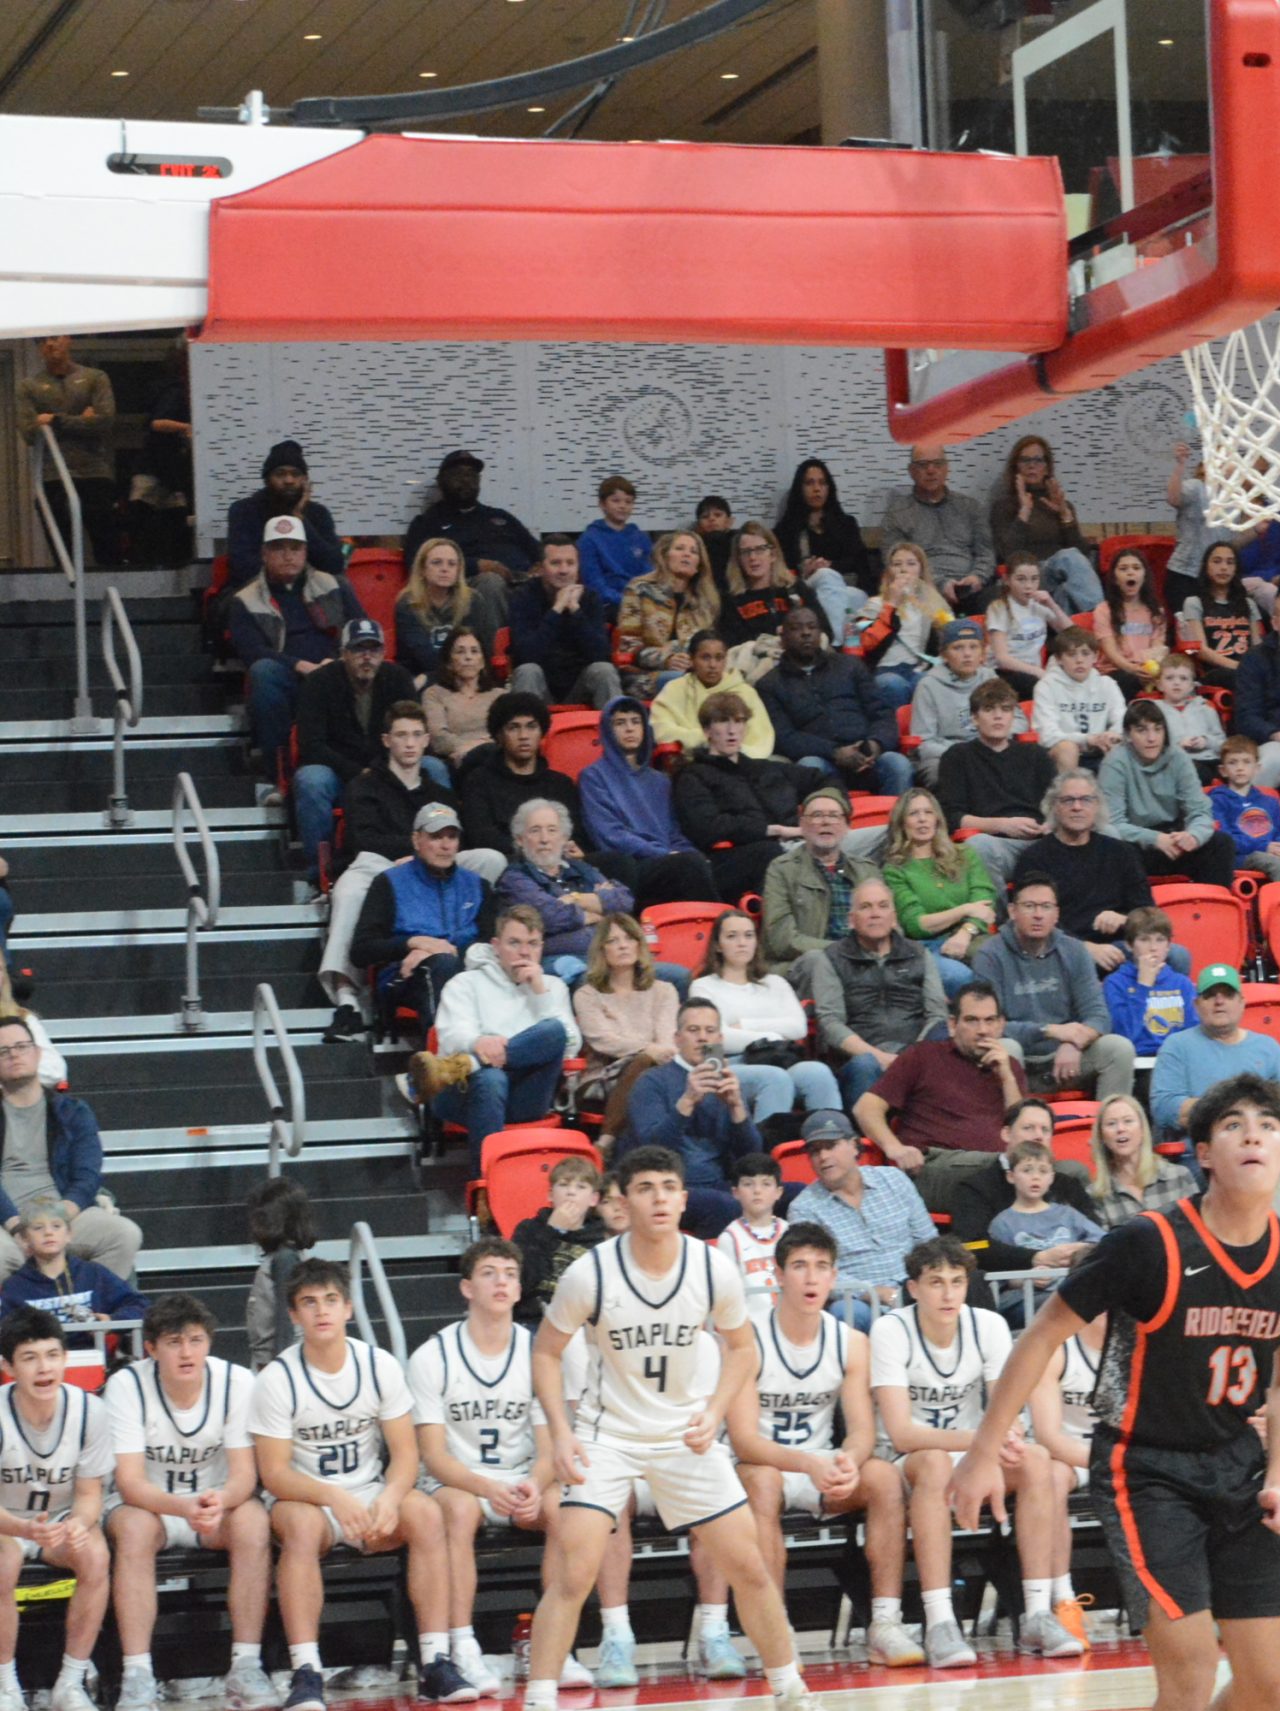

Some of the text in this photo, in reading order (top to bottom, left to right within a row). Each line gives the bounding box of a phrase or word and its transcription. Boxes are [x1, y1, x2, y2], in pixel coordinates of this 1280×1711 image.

[608, 1322, 698, 1351] STAPLES
[644, 1355, 668, 1393] 4
[1206, 1345, 1259, 1407] 13
[450, 1399, 527, 1421] STAPLES
[480, 1428, 501, 1464] 2
[772, 1411, 813, 1446] 25
[1, 1464, 76, 1485] STAPLE
[317, 1441, 359, 1477] 20
[166, 1469, 198, 1494] 14
